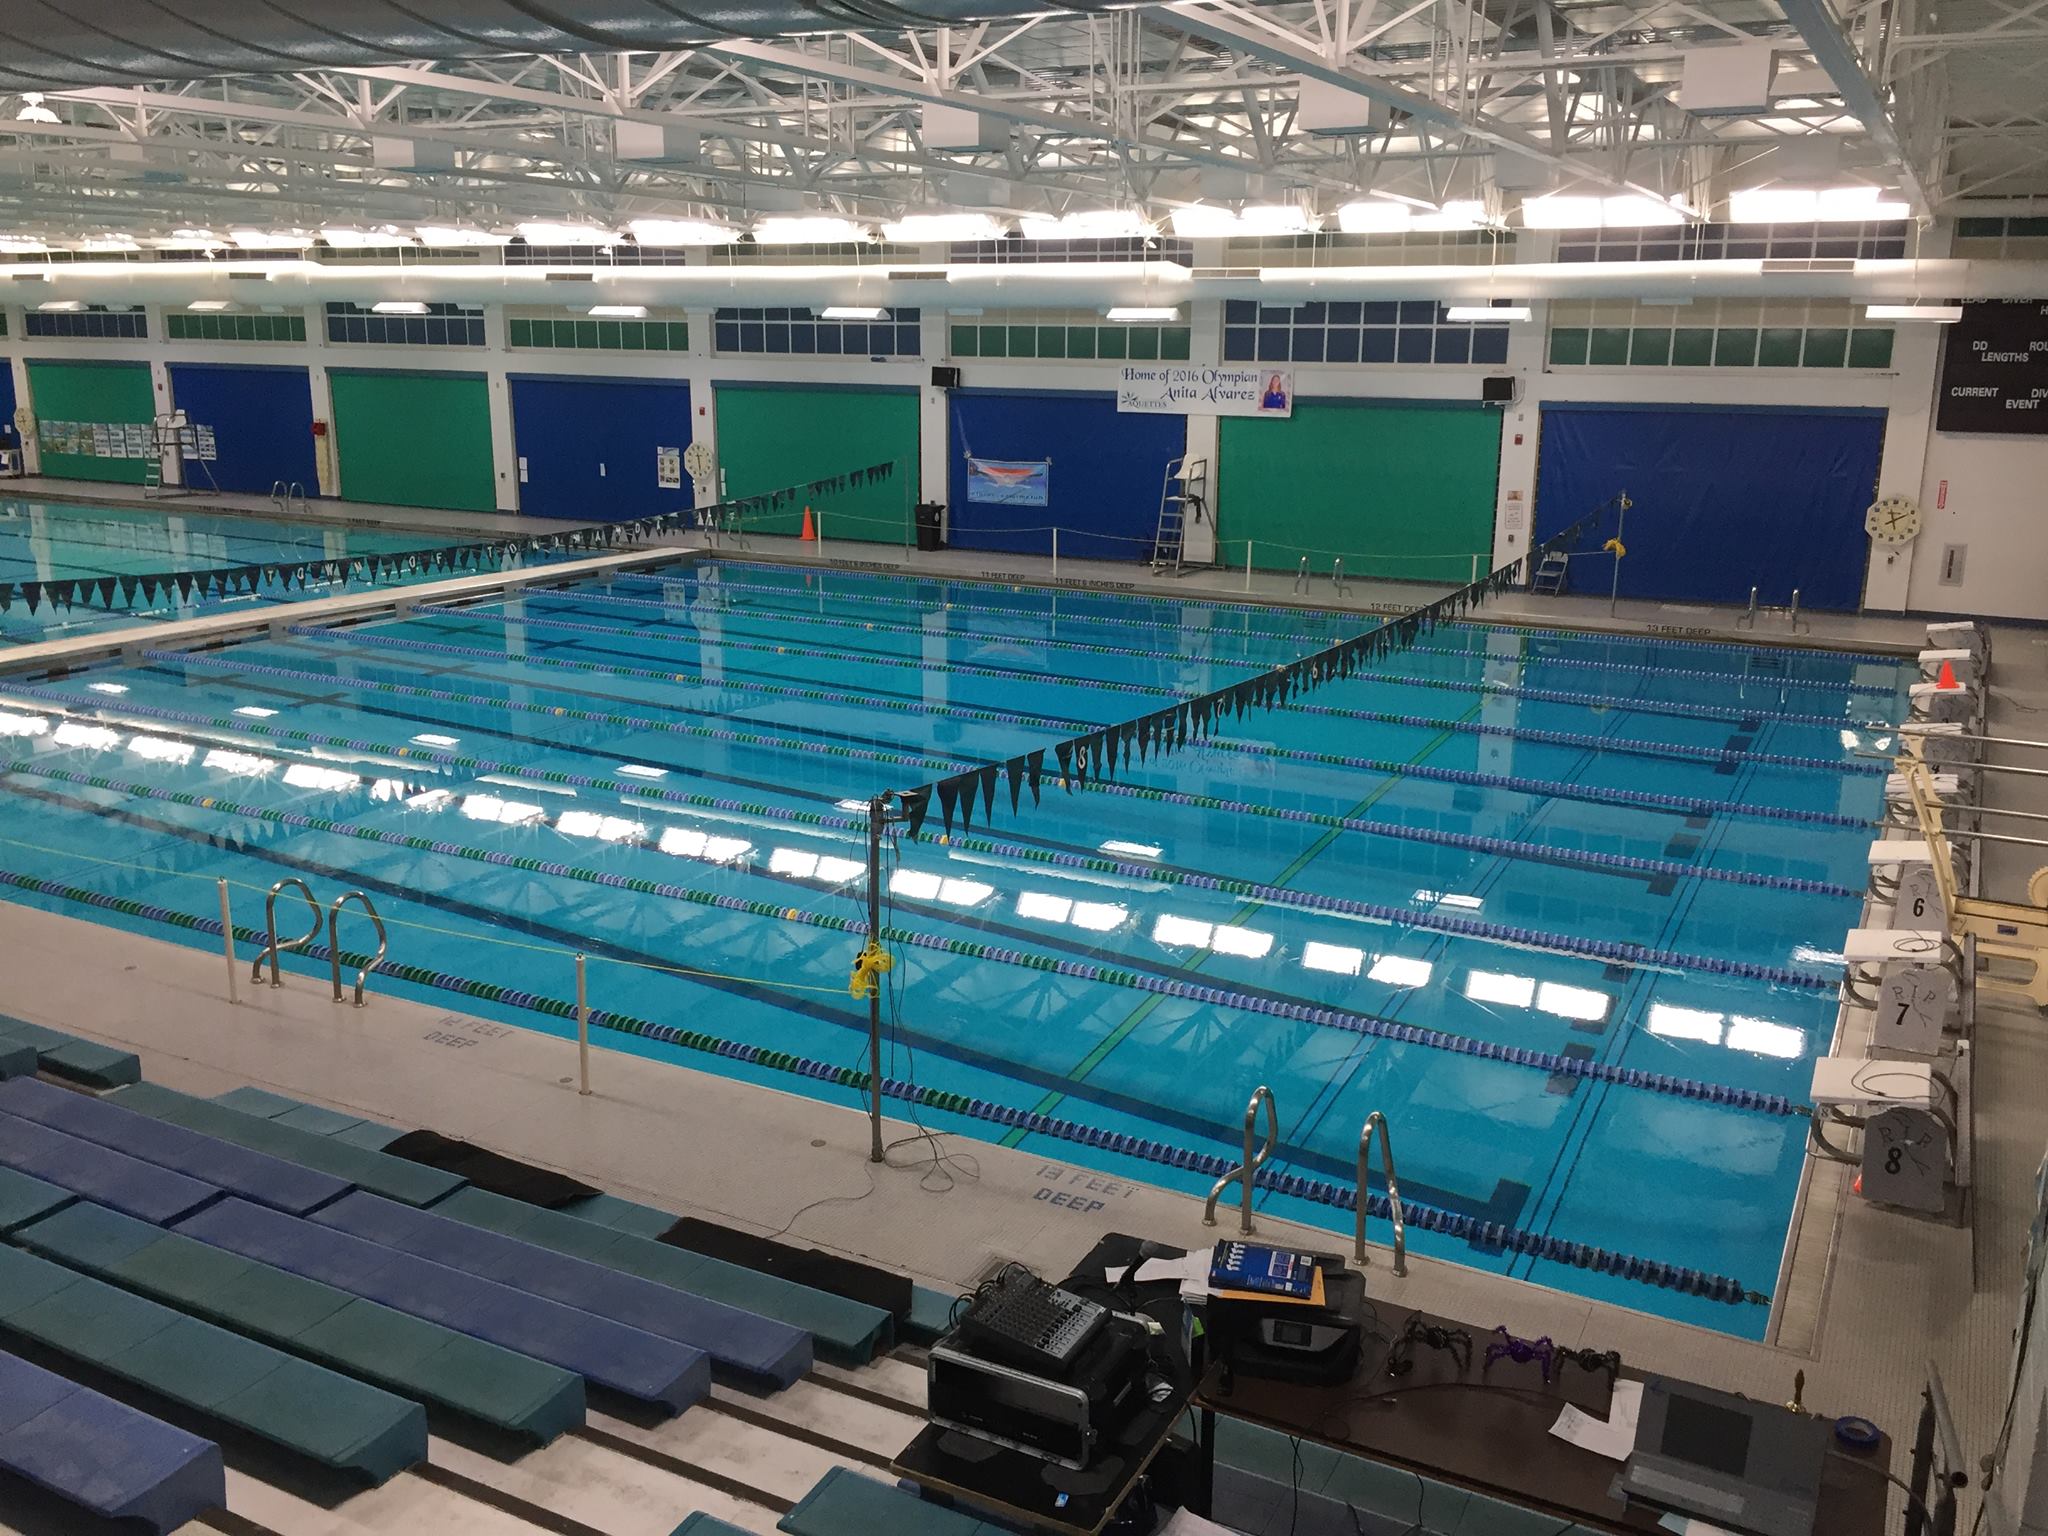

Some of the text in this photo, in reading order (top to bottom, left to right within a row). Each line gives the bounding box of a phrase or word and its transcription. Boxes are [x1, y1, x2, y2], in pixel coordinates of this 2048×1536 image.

[1972, 341, 1988, 351] DD
[1981, 352, 2029, 362] LENGTHS
[1121, 368, 1258, 387] Home of 2016 Olympian
[1160, 385, 1256, 403] Anita Alvarez
[1951, 387, 1999, 398] CURRENT
[2005, 399, 2040, 409] EVENT
[1913, 897, 1925, 917] 6
[1896, 1002, 1910, 1025] 7
[423, 1031, 480, 1049] DEEP
[1885, 1146, 1902, 1175] 8
[1068, 1171, 1140, 1199] FEET
[1032, 1187, 1106, 1213] DEEP
